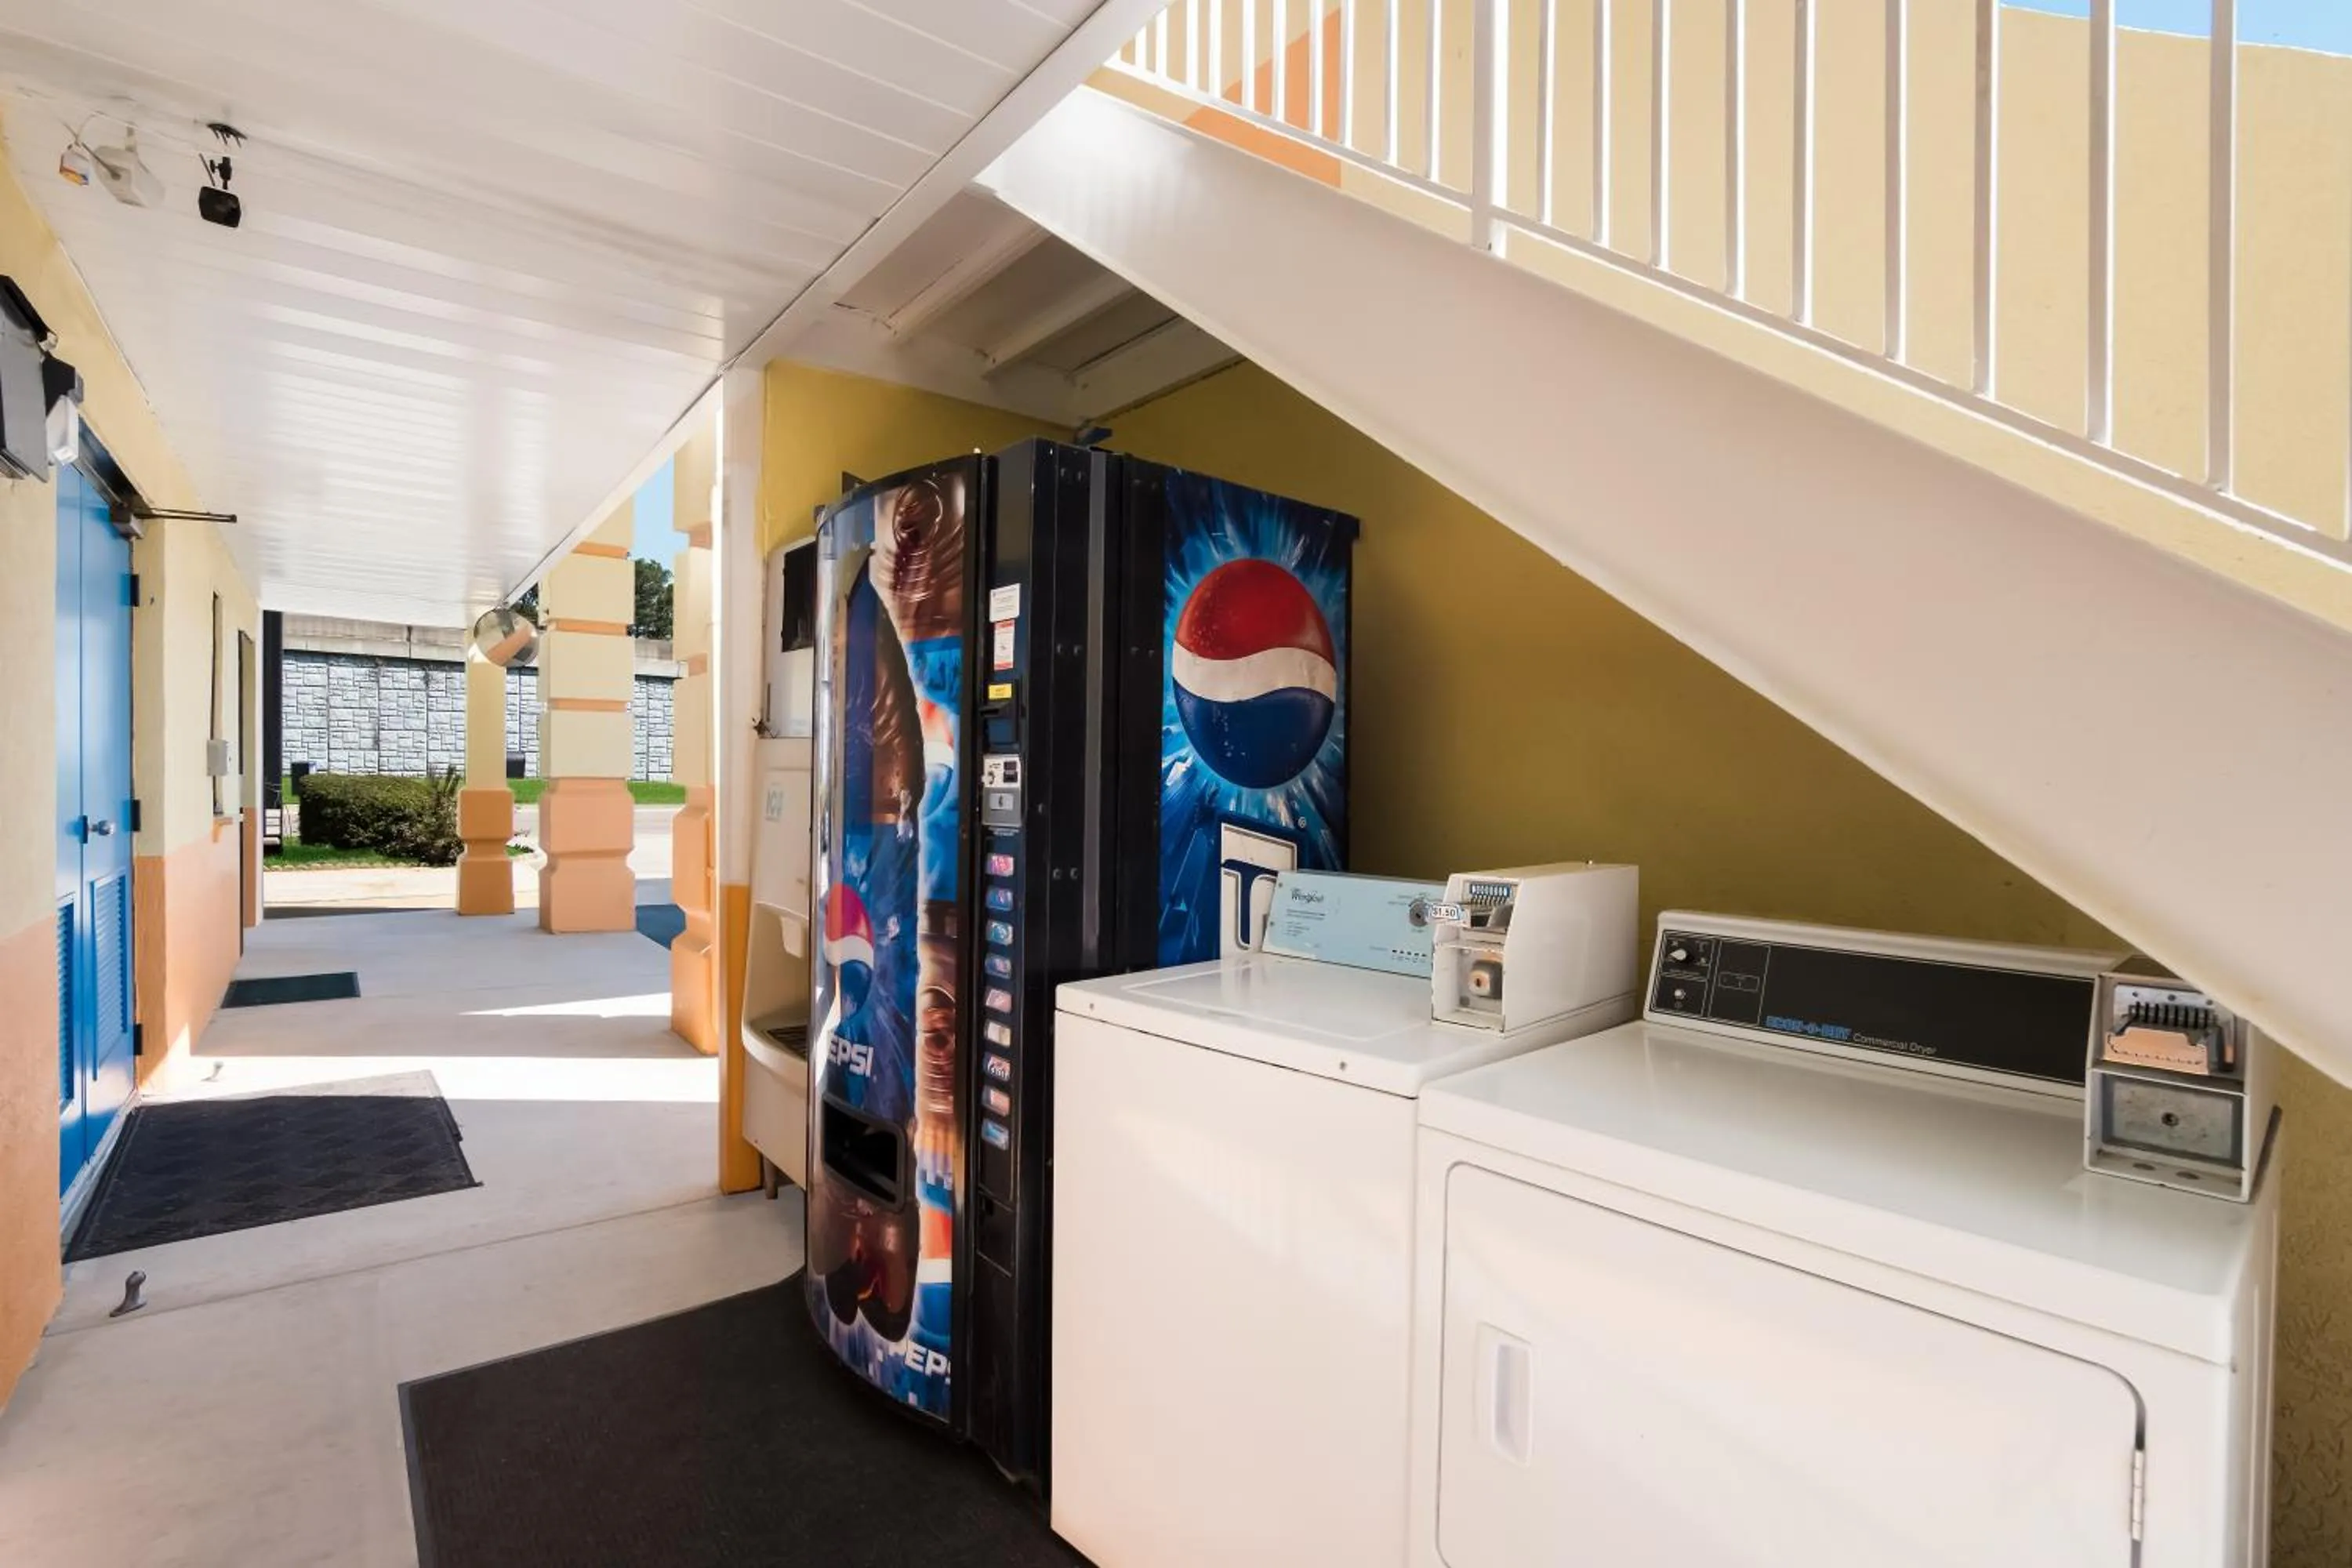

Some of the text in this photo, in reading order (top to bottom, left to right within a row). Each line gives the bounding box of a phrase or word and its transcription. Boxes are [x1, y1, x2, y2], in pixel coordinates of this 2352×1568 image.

[1432, 907, 1457, 917] $1.50
[1853, 1032, 1908, 1050] Commercial
[1909, 1042, 1938, 1055] Dryer
[827, 1034, 874, 1078] EPSI
